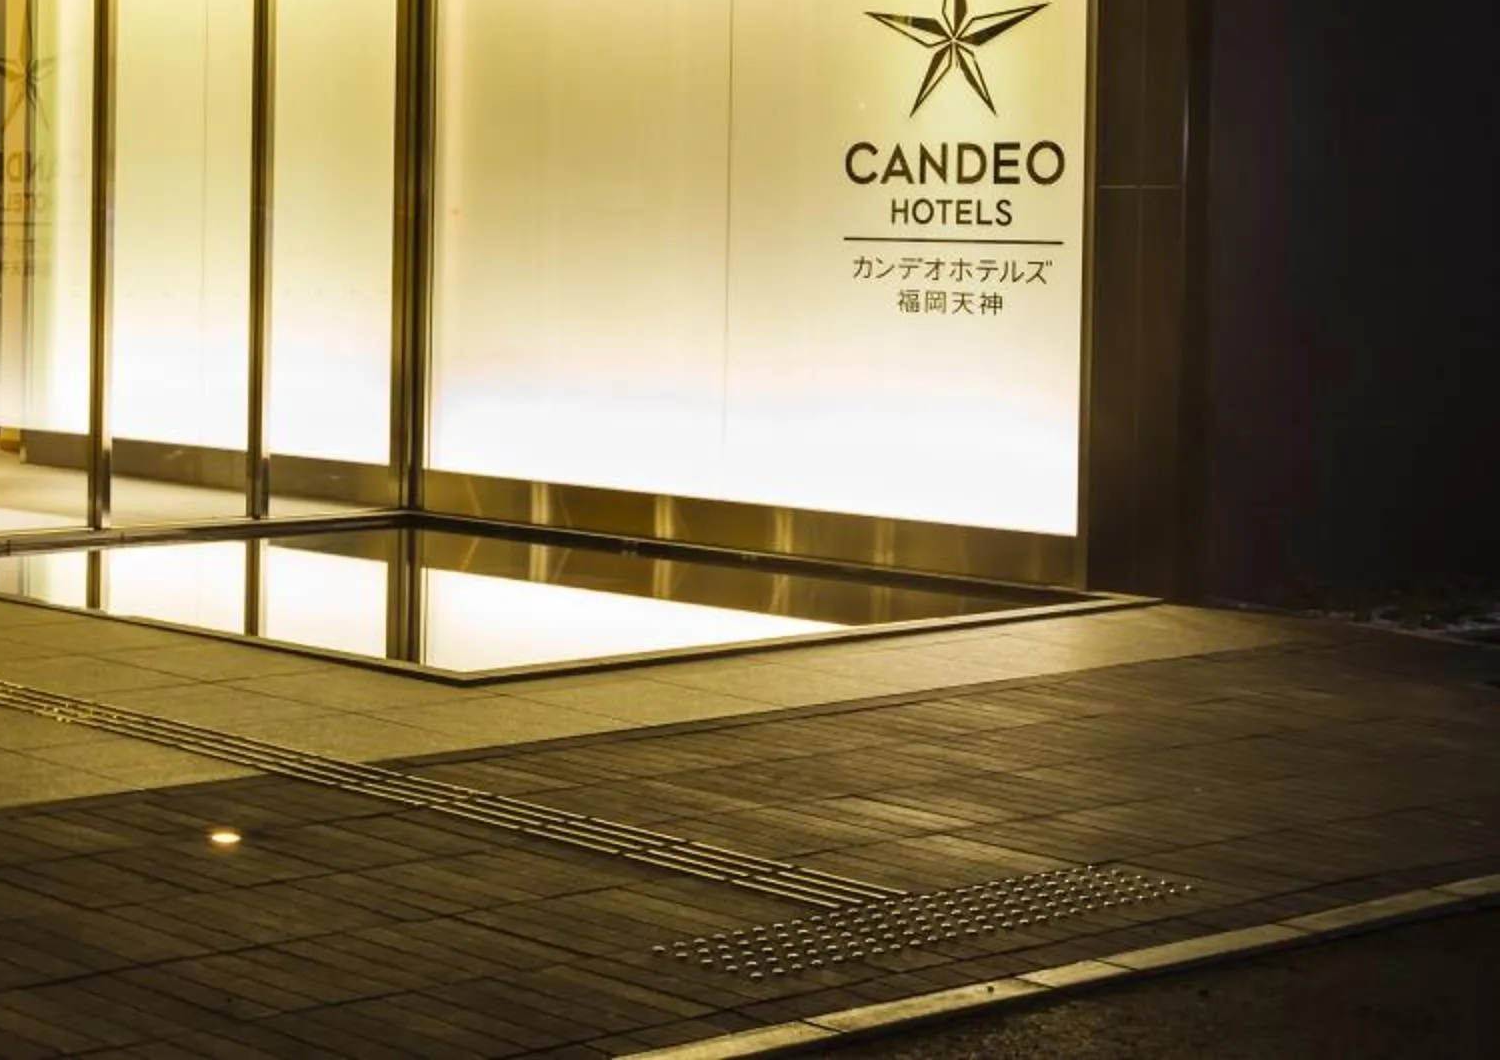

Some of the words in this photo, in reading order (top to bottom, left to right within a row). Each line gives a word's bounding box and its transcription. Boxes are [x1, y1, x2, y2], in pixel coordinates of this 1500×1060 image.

[845, 140, 1065, 186] CANDEO
[891, 198, 1013, 227] HOTELS
[853, 256, 1053, 285] カンデオホテルズ
[897, 289, 1004, 316] 福岡天神
